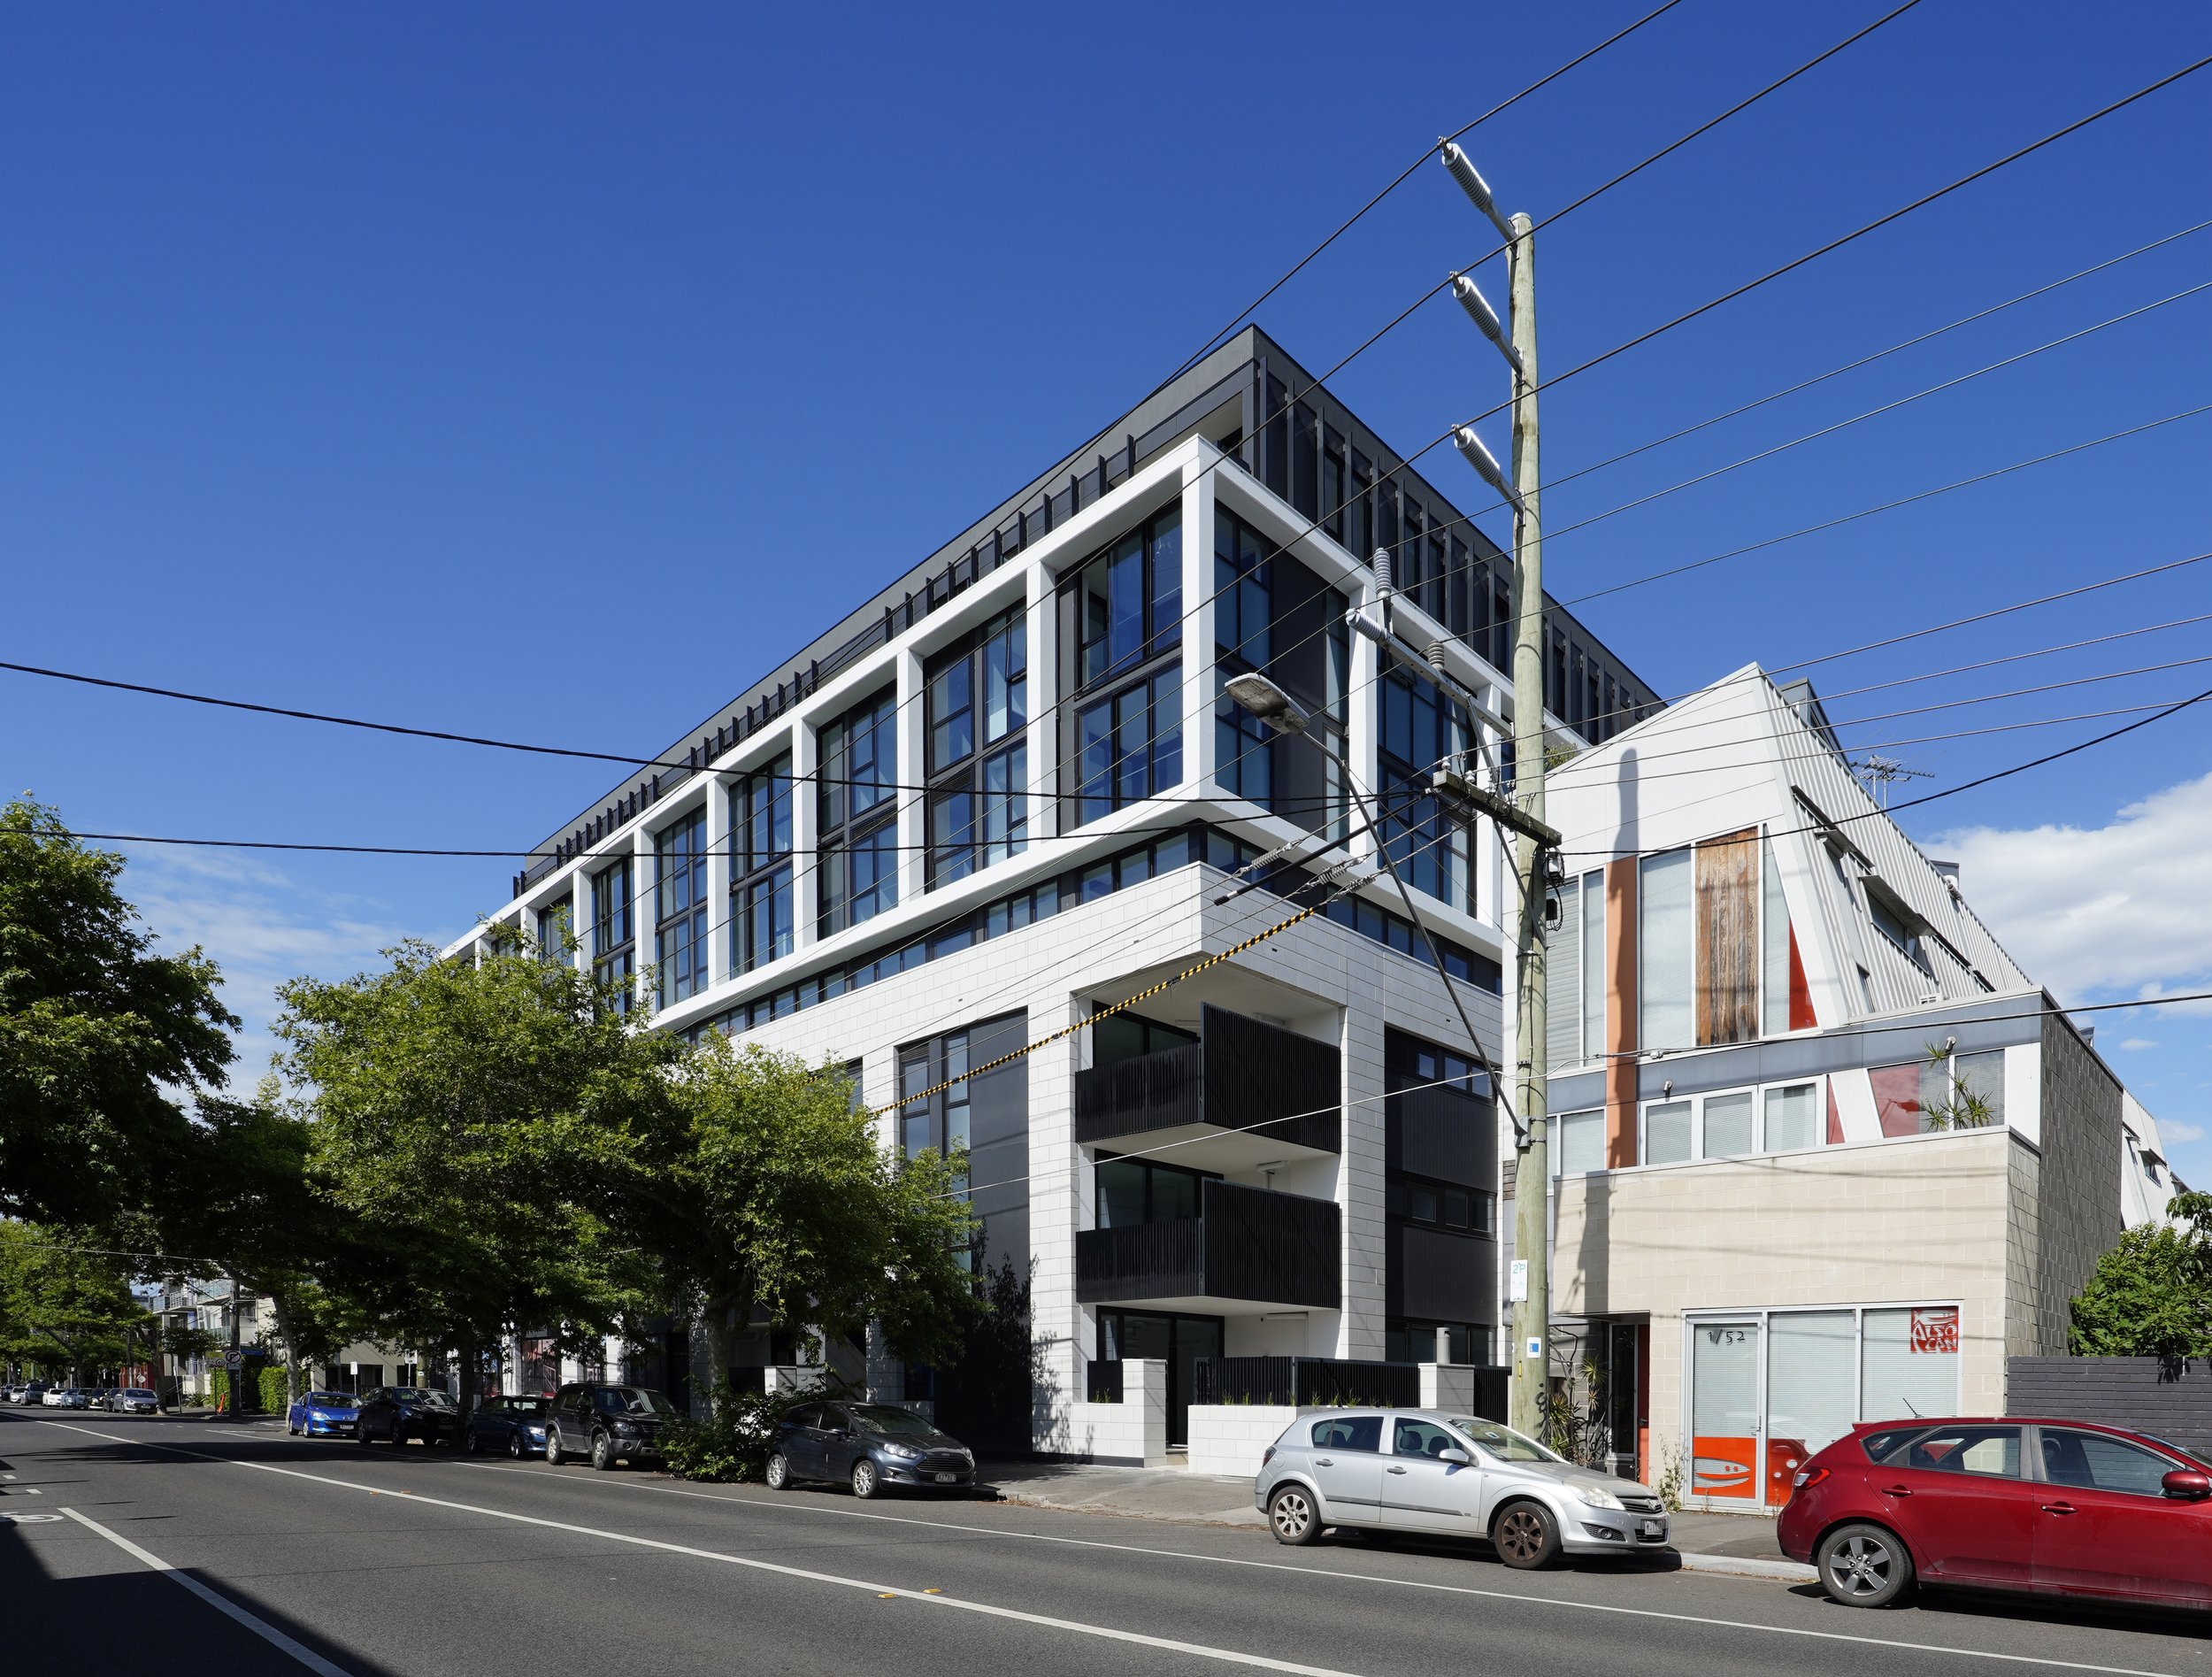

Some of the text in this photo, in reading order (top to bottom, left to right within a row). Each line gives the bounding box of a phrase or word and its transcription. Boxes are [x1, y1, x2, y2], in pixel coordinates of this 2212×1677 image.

[1513, 1264, 1526, 1274] 2P
[1707, 1328, 1746, 1345] 1/52
[1911, 1319, 1957, 1352] ALSO
[1925, 1337, 1957, 1352] CAN
